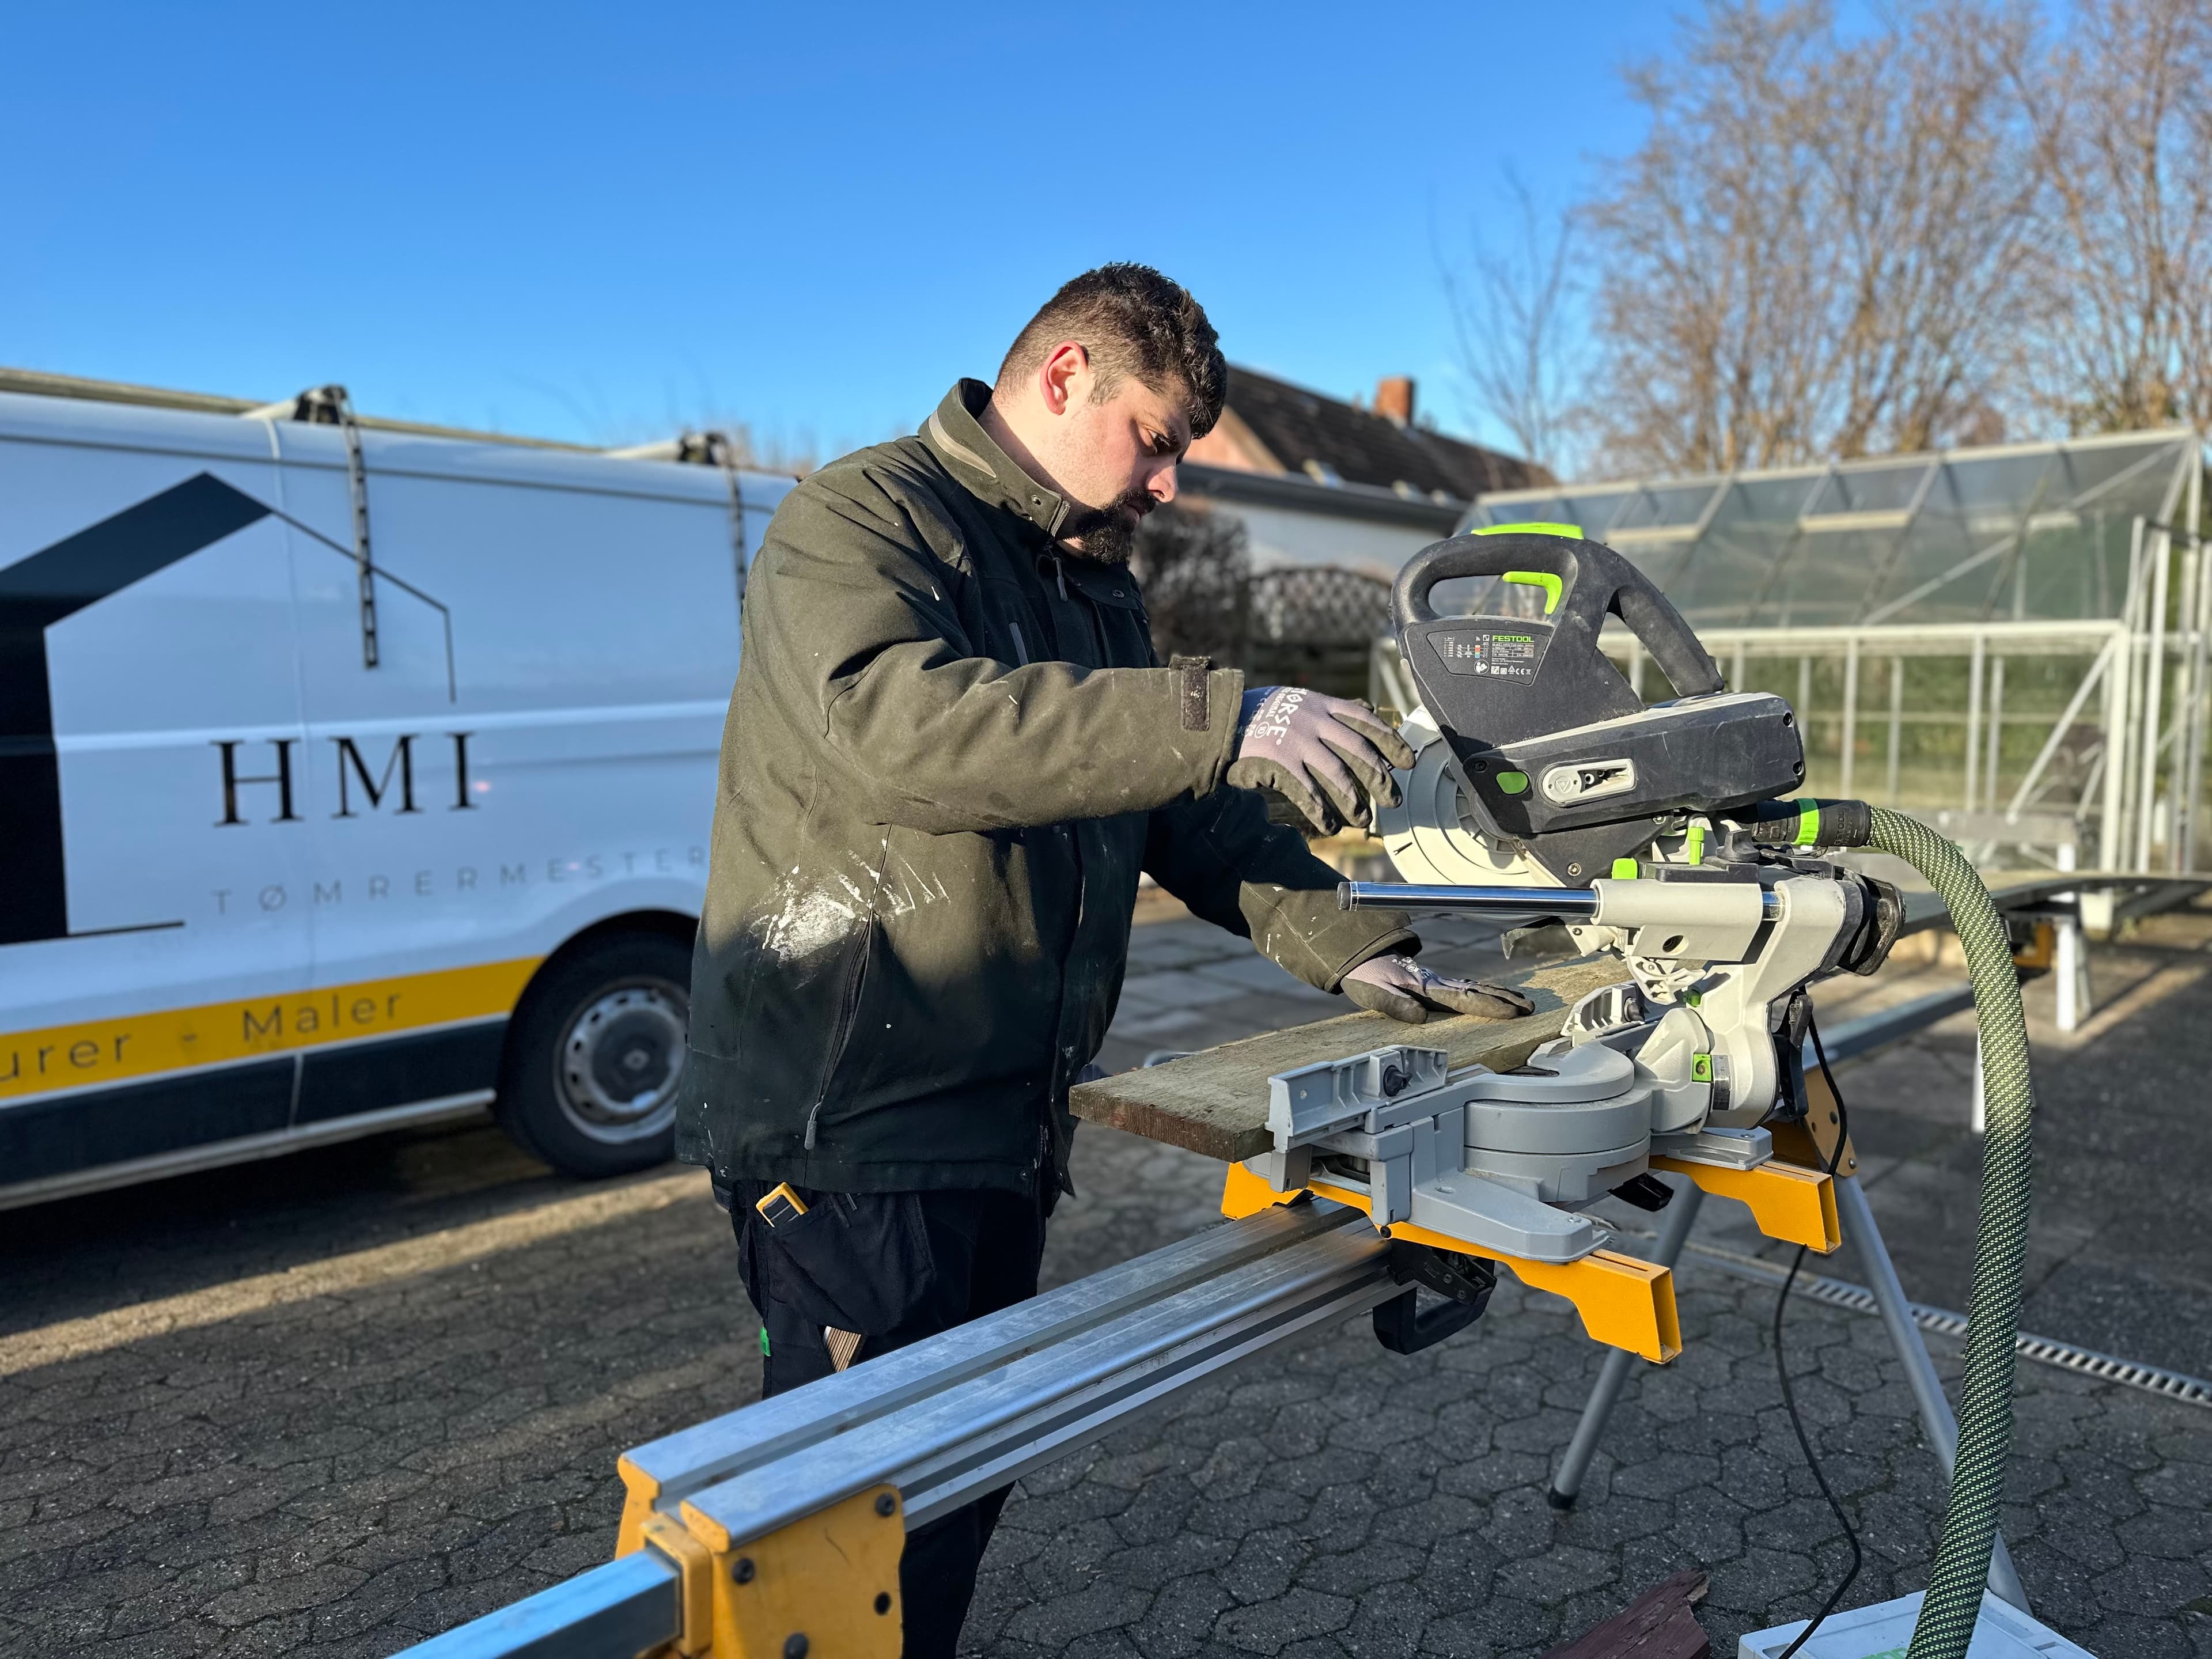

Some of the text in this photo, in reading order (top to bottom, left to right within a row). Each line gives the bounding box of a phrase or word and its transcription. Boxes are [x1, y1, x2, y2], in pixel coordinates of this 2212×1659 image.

[210, 732, 479, 826] HMI
[211, 846, 706, 915] TØMRERMESTER
[243, 993, 402, 1043] Maler
